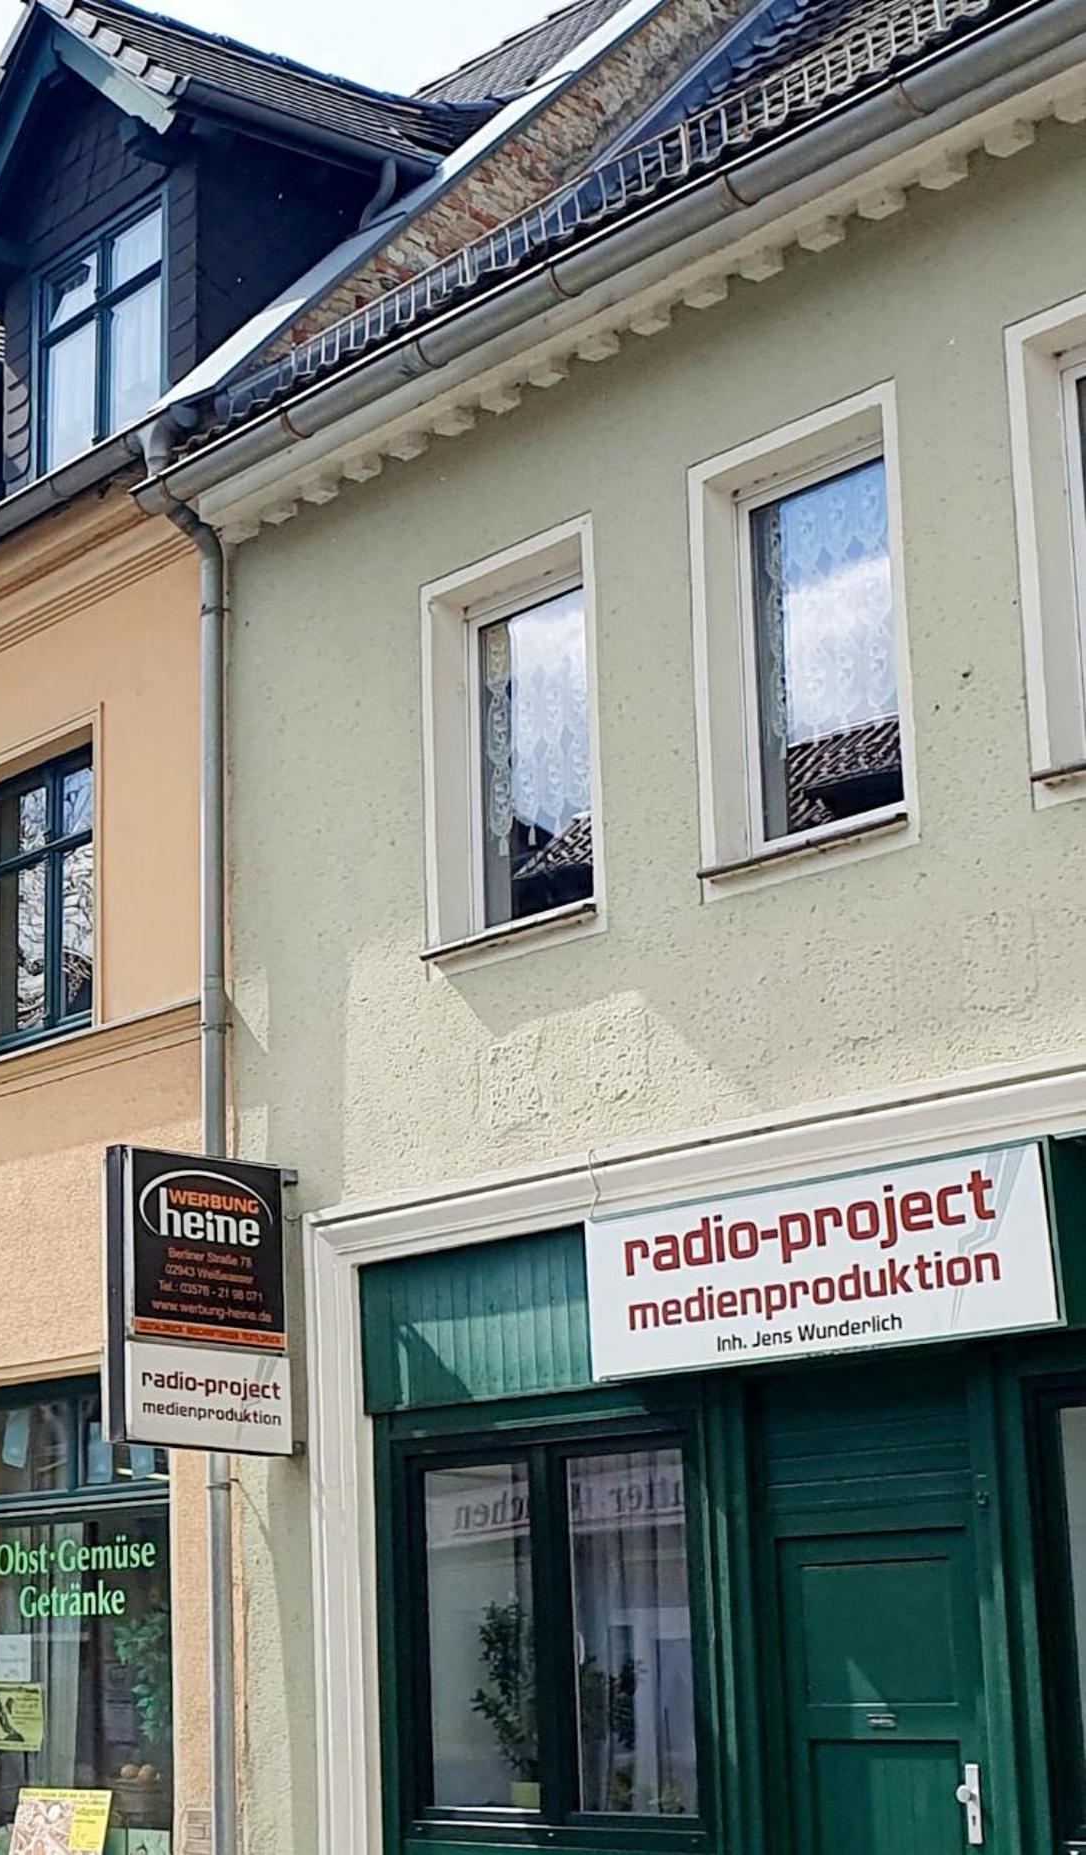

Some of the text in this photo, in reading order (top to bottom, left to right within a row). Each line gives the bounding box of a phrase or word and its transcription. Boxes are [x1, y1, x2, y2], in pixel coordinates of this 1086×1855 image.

[158, 1186, 261, 1247] heine
[168, 1188, 260, 1215] WERBUNG
[623, 1169, 996, 1277] radio-project
[628, 1251, 1002, 1330] medienproduktion
[717, 1313, 903, 1353] Inh. Jens Wunderlich
[141, 1370, 282, 1400] radio-project
[142, 1401, 282, 1427] medienproduktion
[19, 1579, 126, 1618] Getränke
